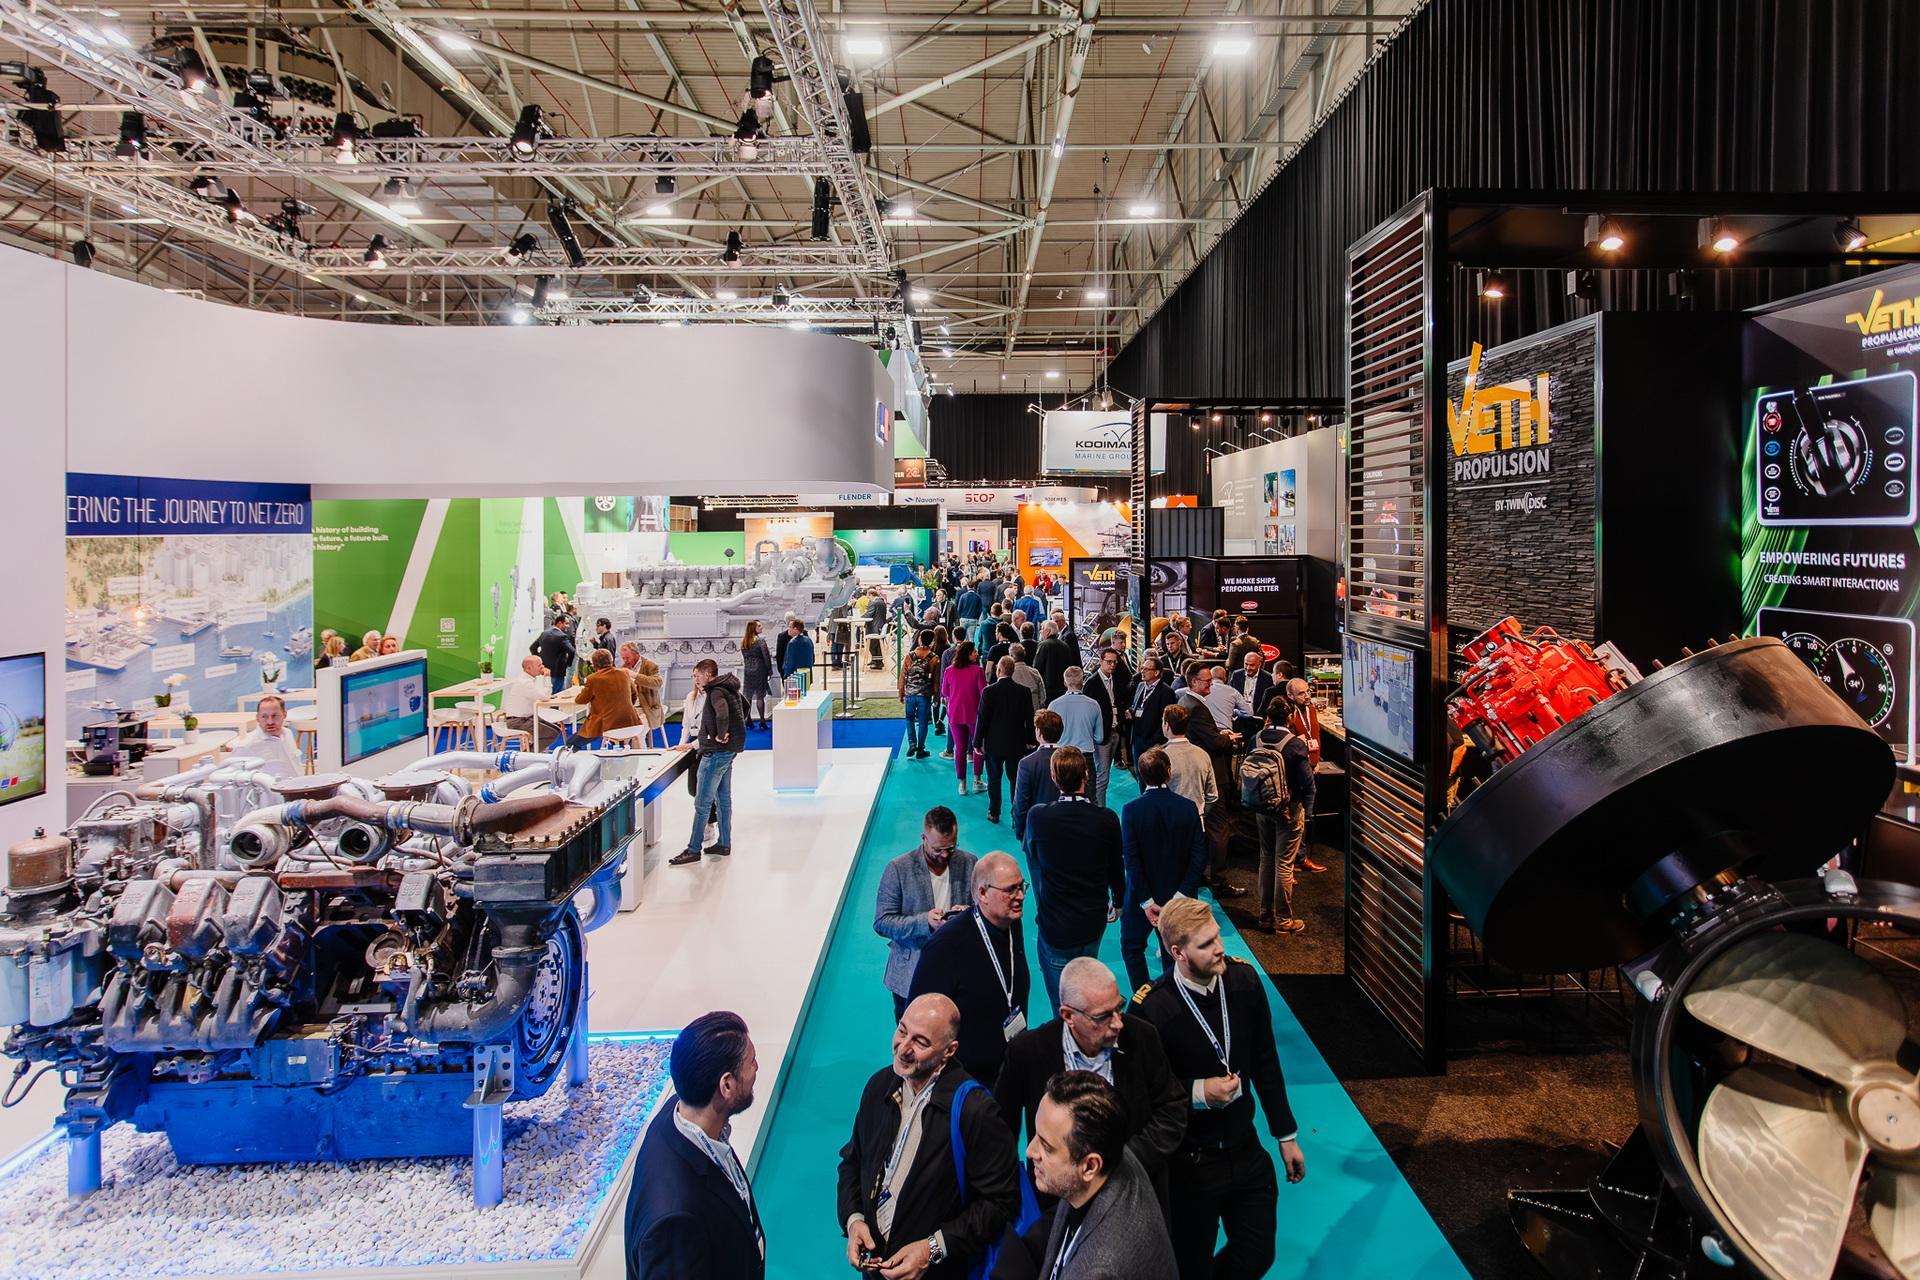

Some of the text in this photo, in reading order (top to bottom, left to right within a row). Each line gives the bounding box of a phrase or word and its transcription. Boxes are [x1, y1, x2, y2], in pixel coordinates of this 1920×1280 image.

[1846, 288, 1920, 336] VETH
[1447, 341, 1550, 457] VETH
[1454, 448, 1550, 481] PROPULSION
[66, 495, 304, 525] ERING THE JOURNEY TO NET ZERO
[1528, 496, 1547, 509] DISC
[350, 525, 379, 534] building
[1759, 551, 1906, 569] EMPOWERING FUTURES
[1083, 563, 1116, 581] VETH
[1221, 585, 1253, 593] PERFORM
[1763, 574, 1900, 592] CREATING SMART INTERACTIONS
[1807, 642, 1818, 650] 100
